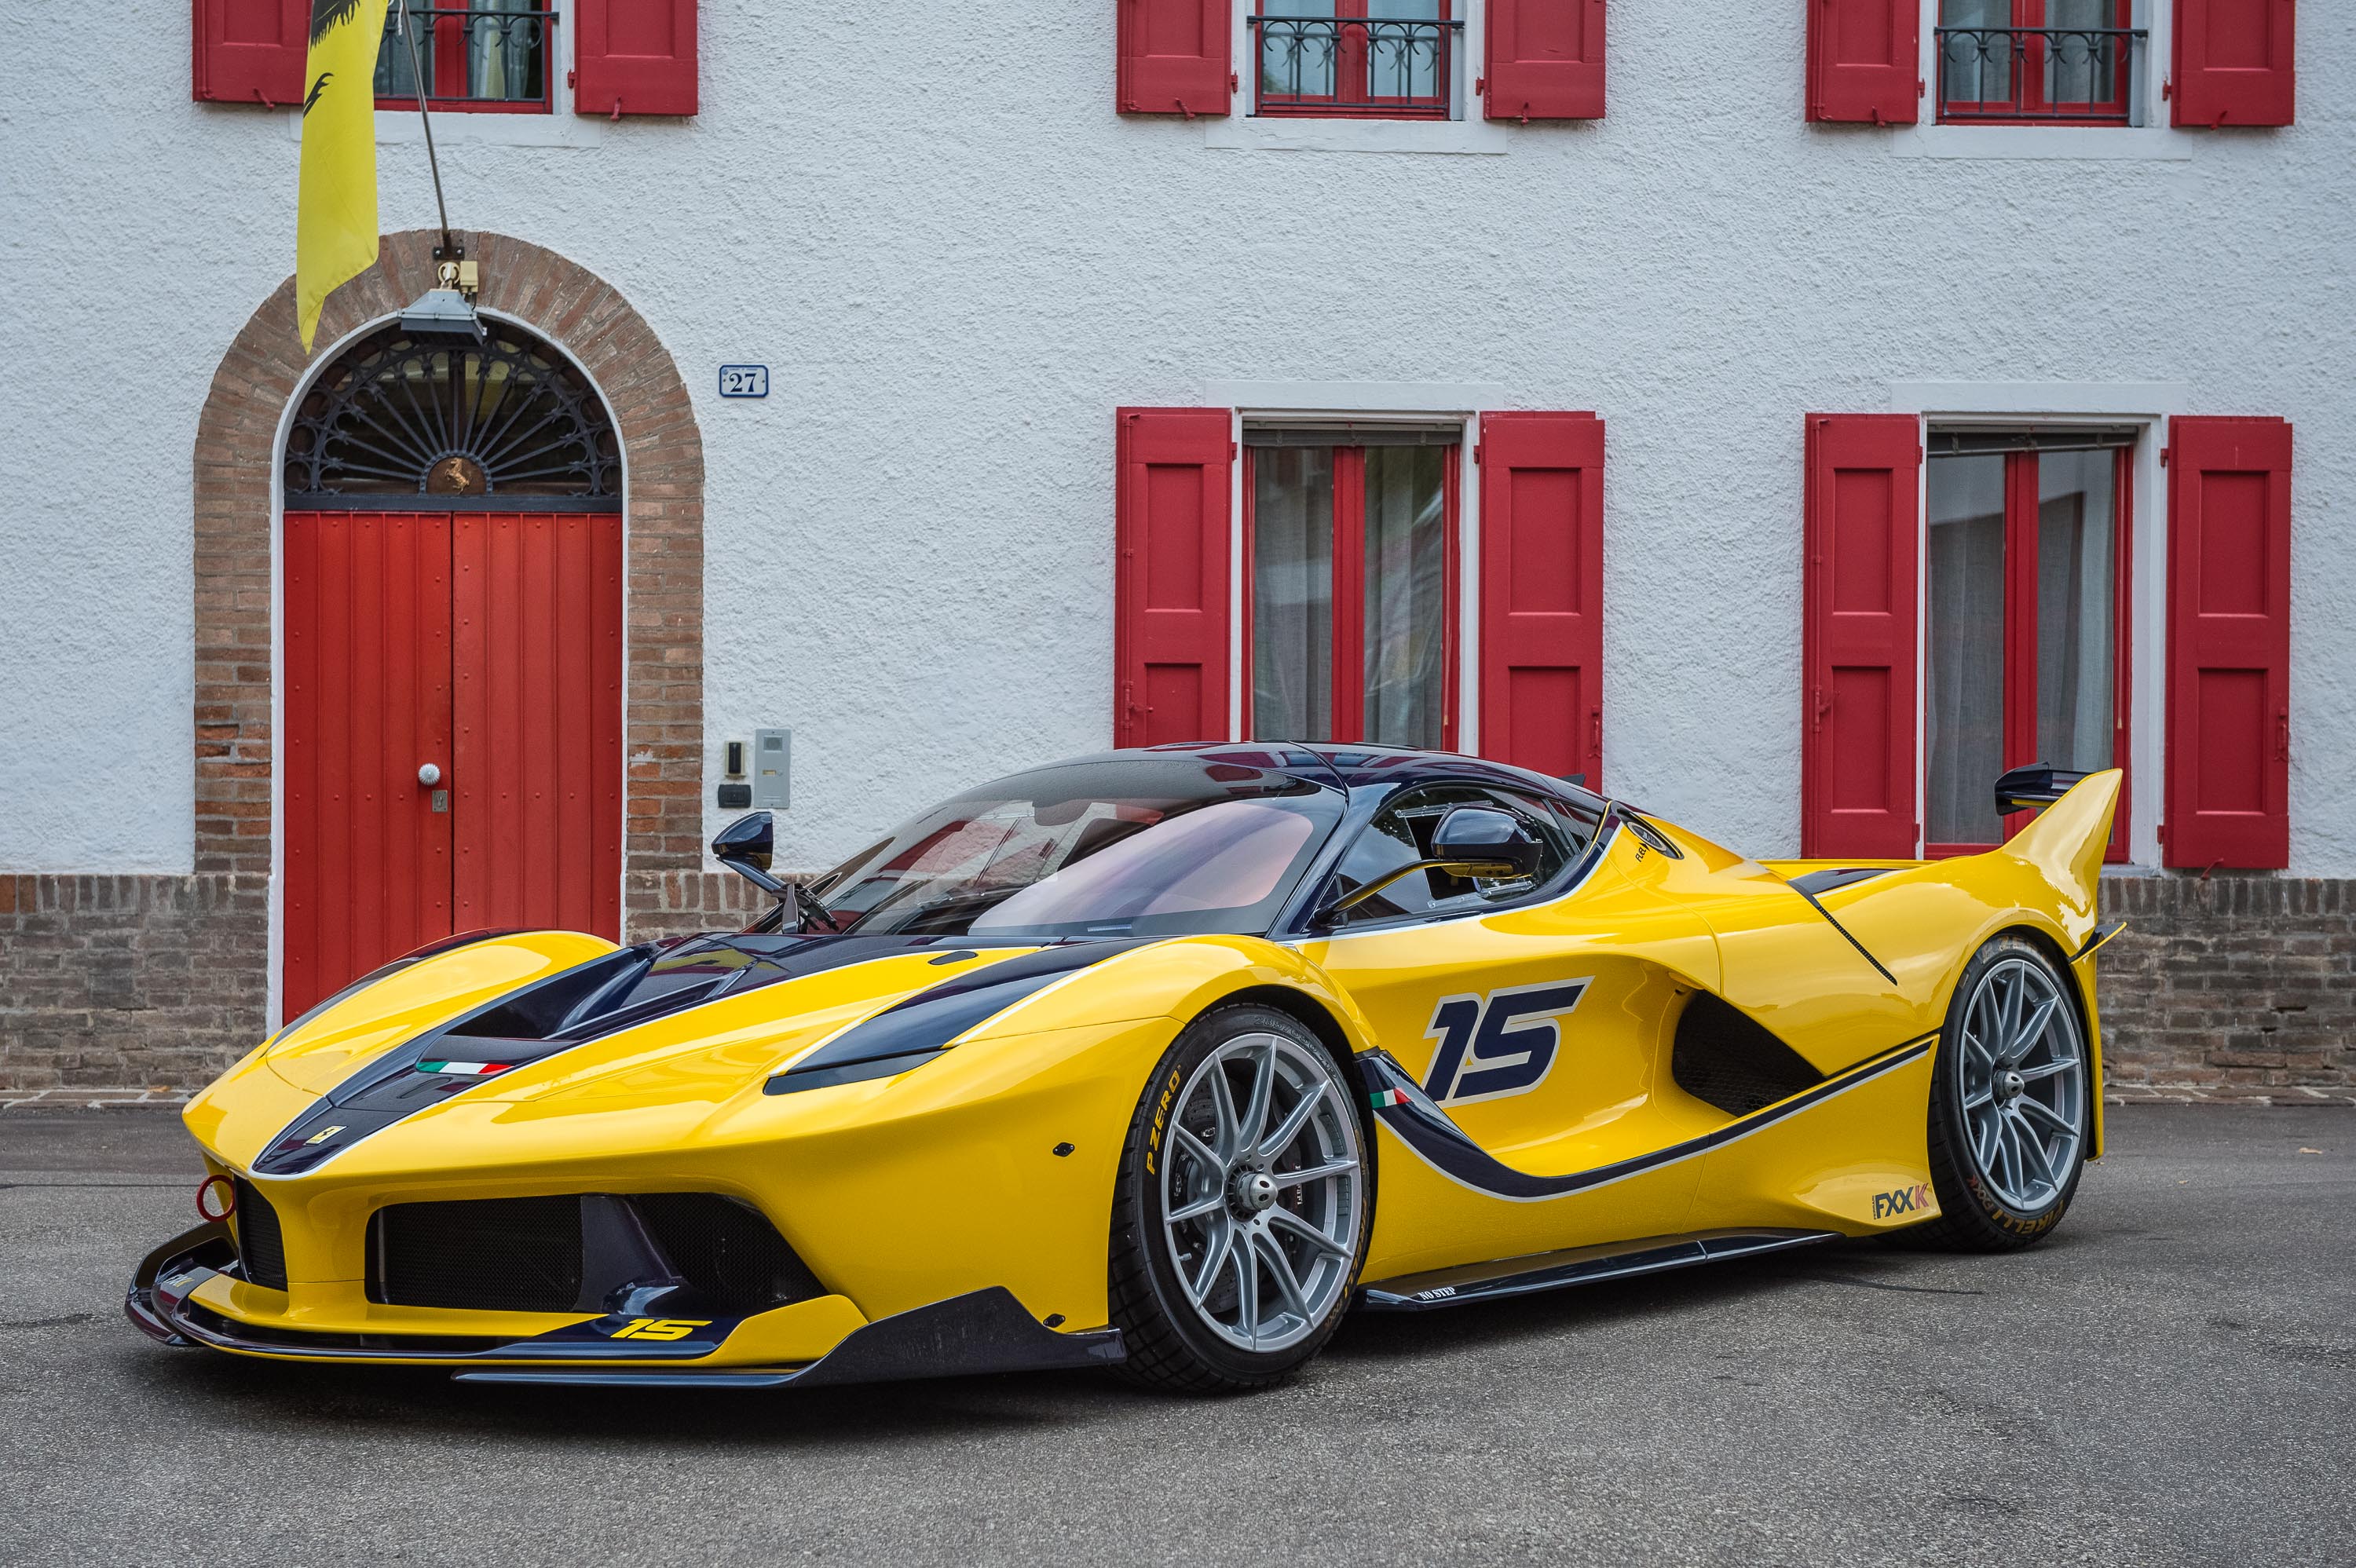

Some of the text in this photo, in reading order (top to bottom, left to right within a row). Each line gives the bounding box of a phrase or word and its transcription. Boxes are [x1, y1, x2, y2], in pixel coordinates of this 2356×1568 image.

[729, 372, 757, 393] 27
[1635, 846, 1647, 862] FUEL
[1420, 975, 1596, 1109] 15
[1417, 1286, 1456, 1300] NO STEP
[610, 1318, 713, 1341] 15
